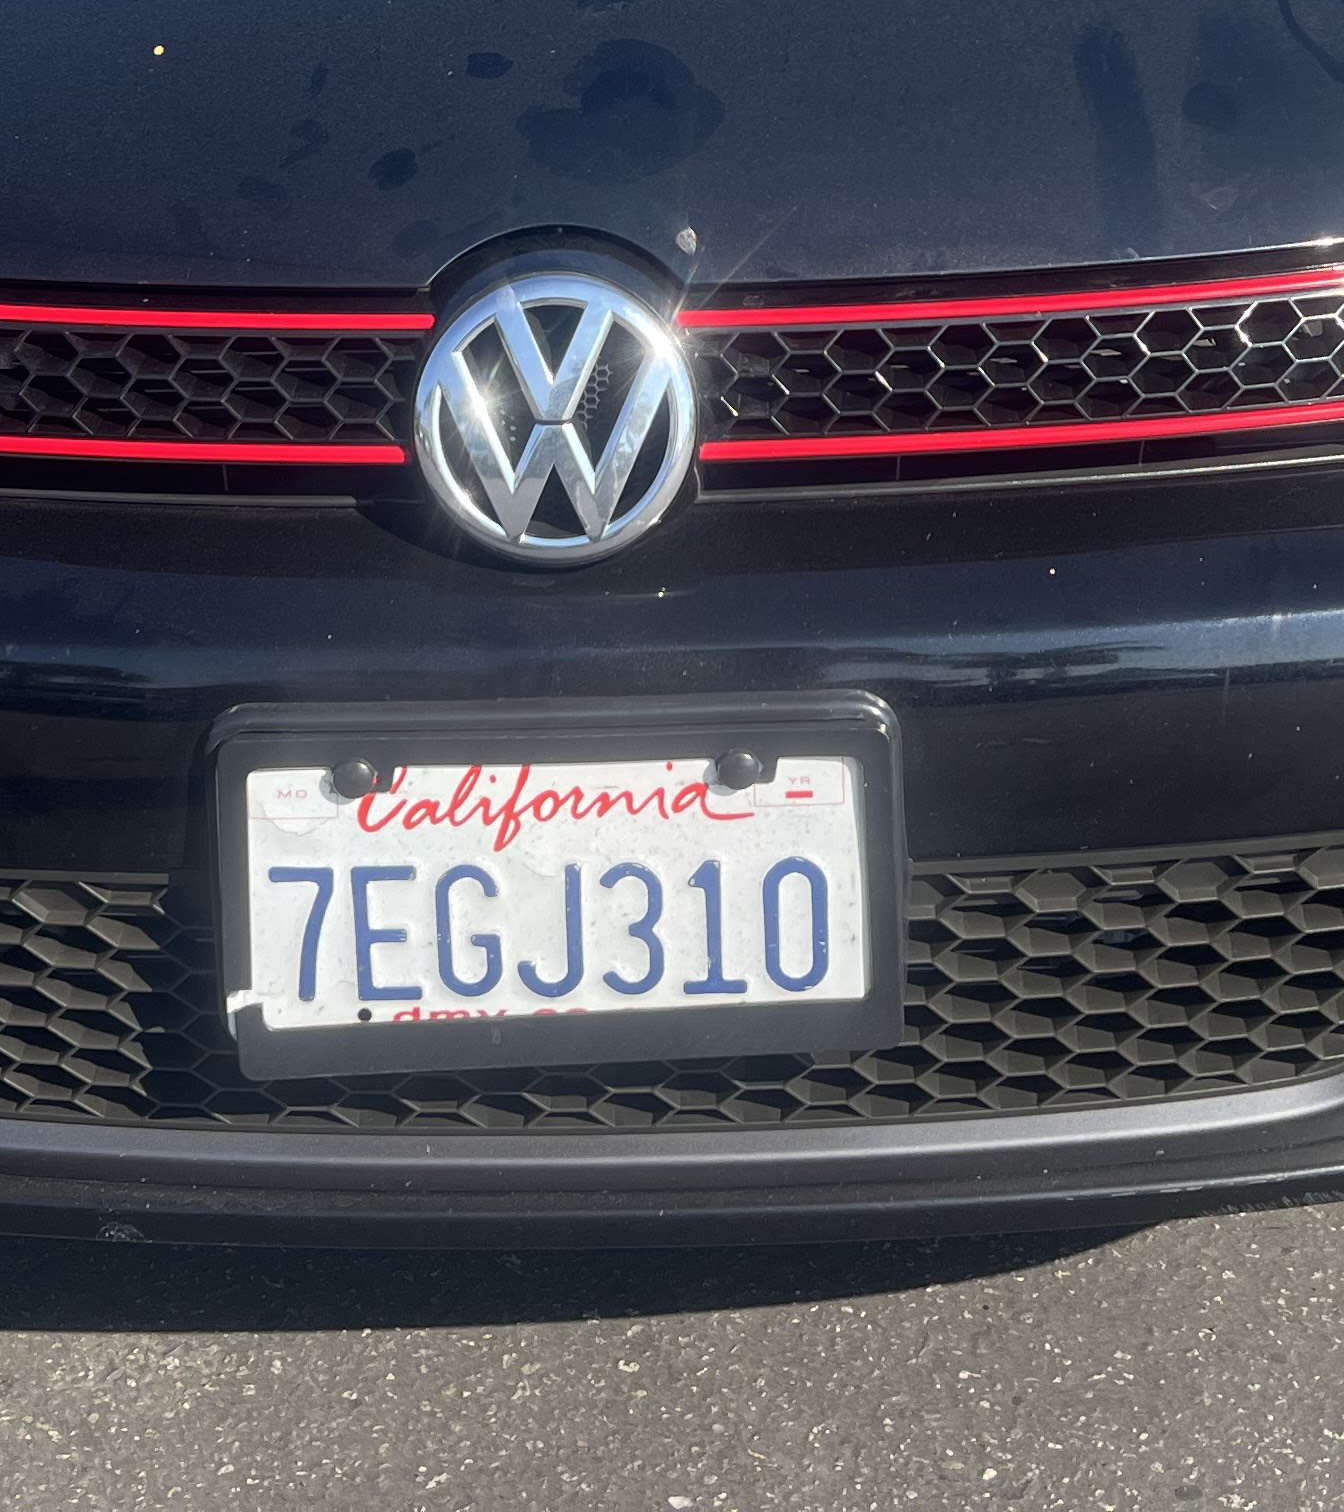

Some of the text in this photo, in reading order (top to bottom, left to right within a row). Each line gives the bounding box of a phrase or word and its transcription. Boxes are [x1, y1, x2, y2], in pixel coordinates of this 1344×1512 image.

[276, 764, 810, 852] MO California YR
[267, 856, 829, 1002] 7EGJ310
